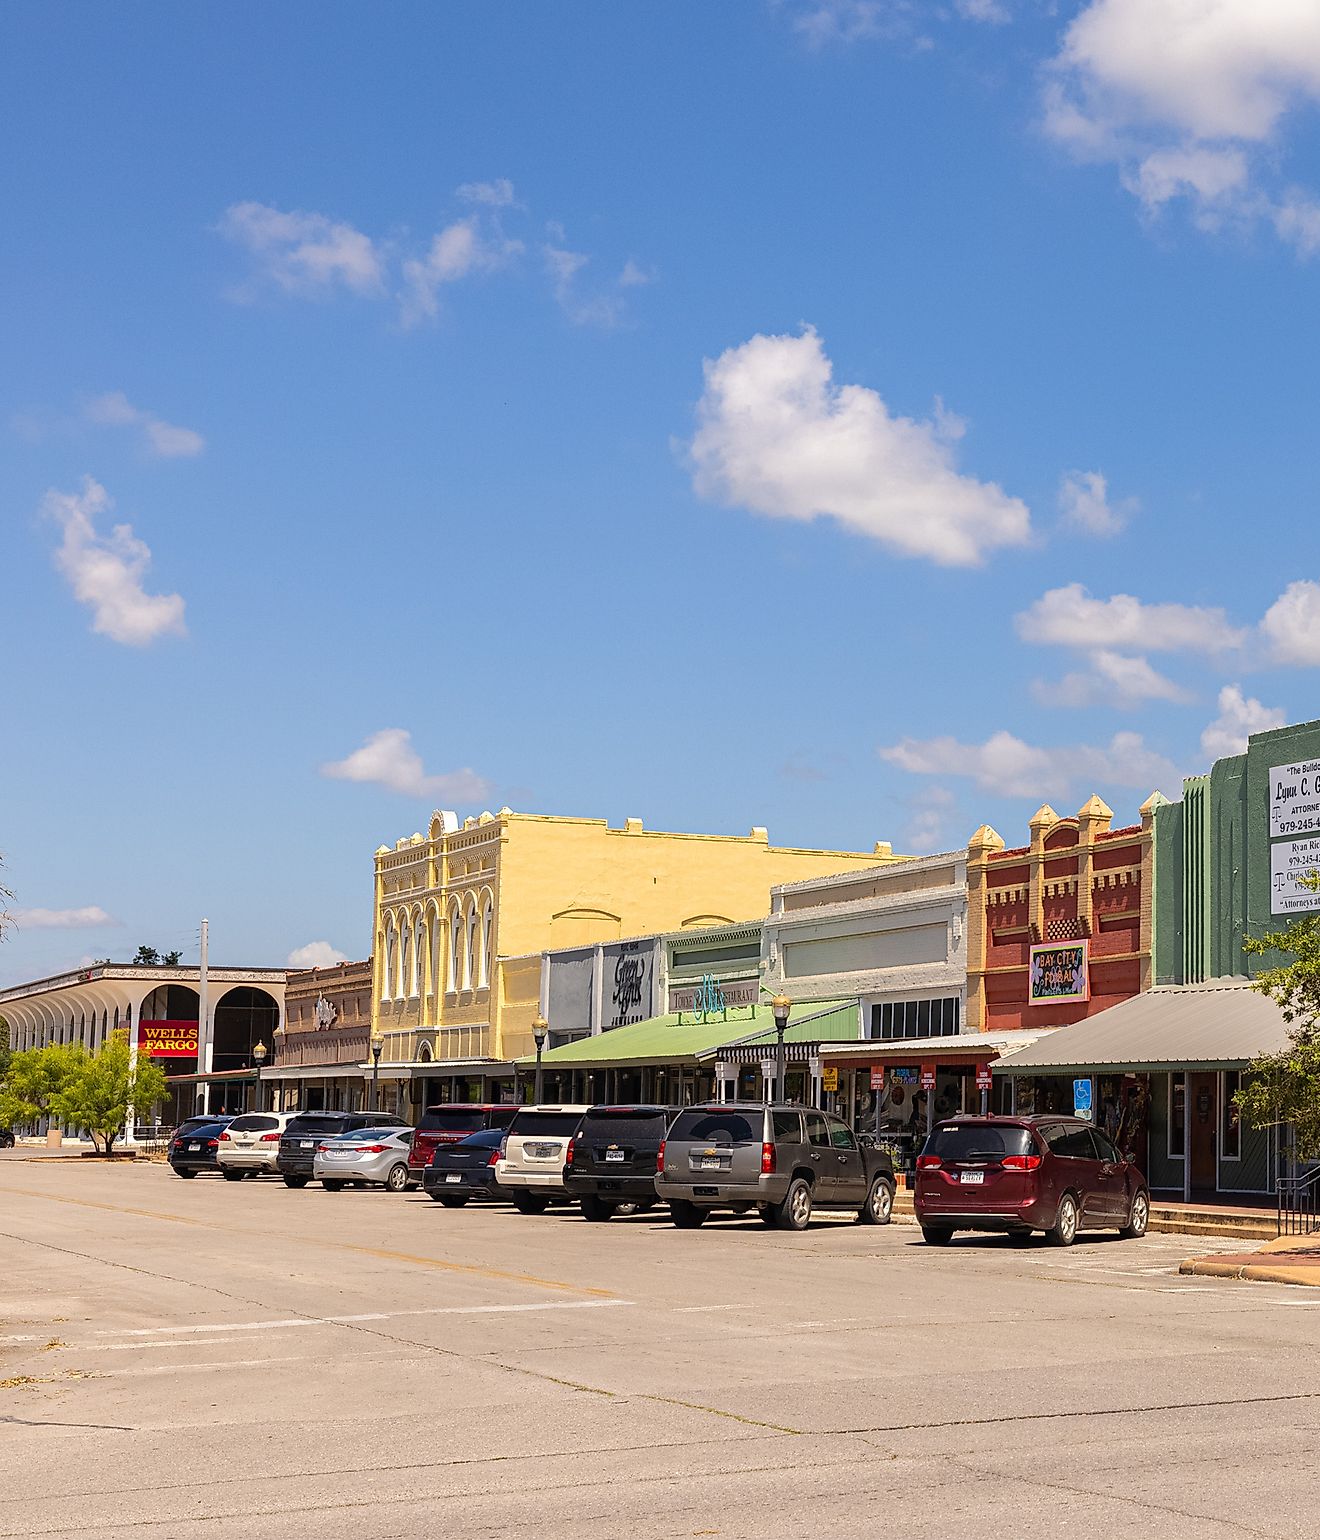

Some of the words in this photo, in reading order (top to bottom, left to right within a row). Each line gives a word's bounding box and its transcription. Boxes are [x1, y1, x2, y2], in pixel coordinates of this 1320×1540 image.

[1275, 782, 1297, 803] Lynn
[1301, 777, 1311, 796] C.
[1292, 843, 1308, 854] Ryan
[1040, 954, 1055, 968] BAY
[1056, 950, 1077, 965] CITY
[144, 1028, 198, 1039] WELLS
[145, 1039, 198, 1050] FARGO
